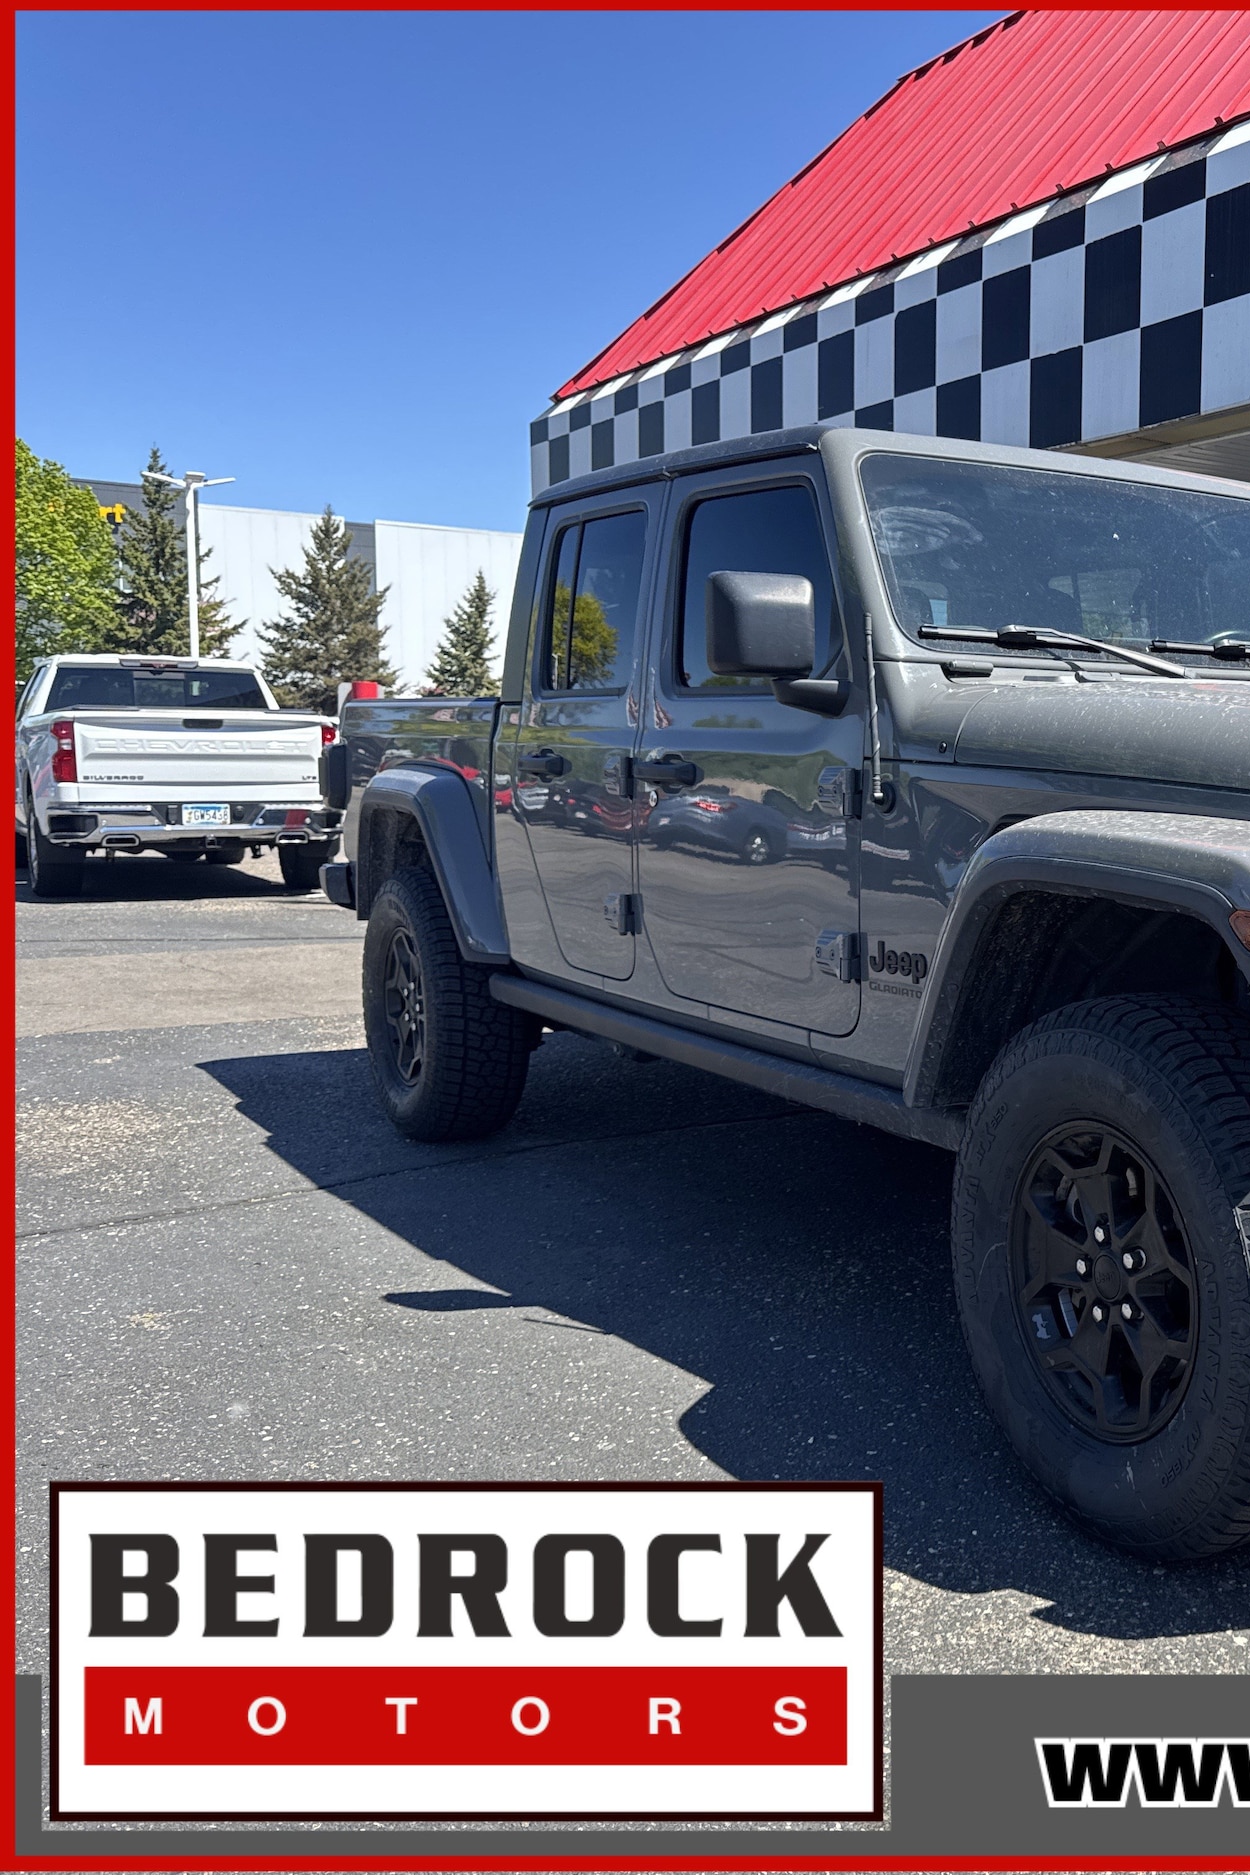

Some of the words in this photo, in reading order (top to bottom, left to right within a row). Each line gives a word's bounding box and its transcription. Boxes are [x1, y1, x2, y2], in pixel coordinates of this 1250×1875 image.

[95, 738, 308, 752] CHEVROLET
[869, 940, 928, 984] Jeep
[869, 981, 923, 999] GLADIATO
